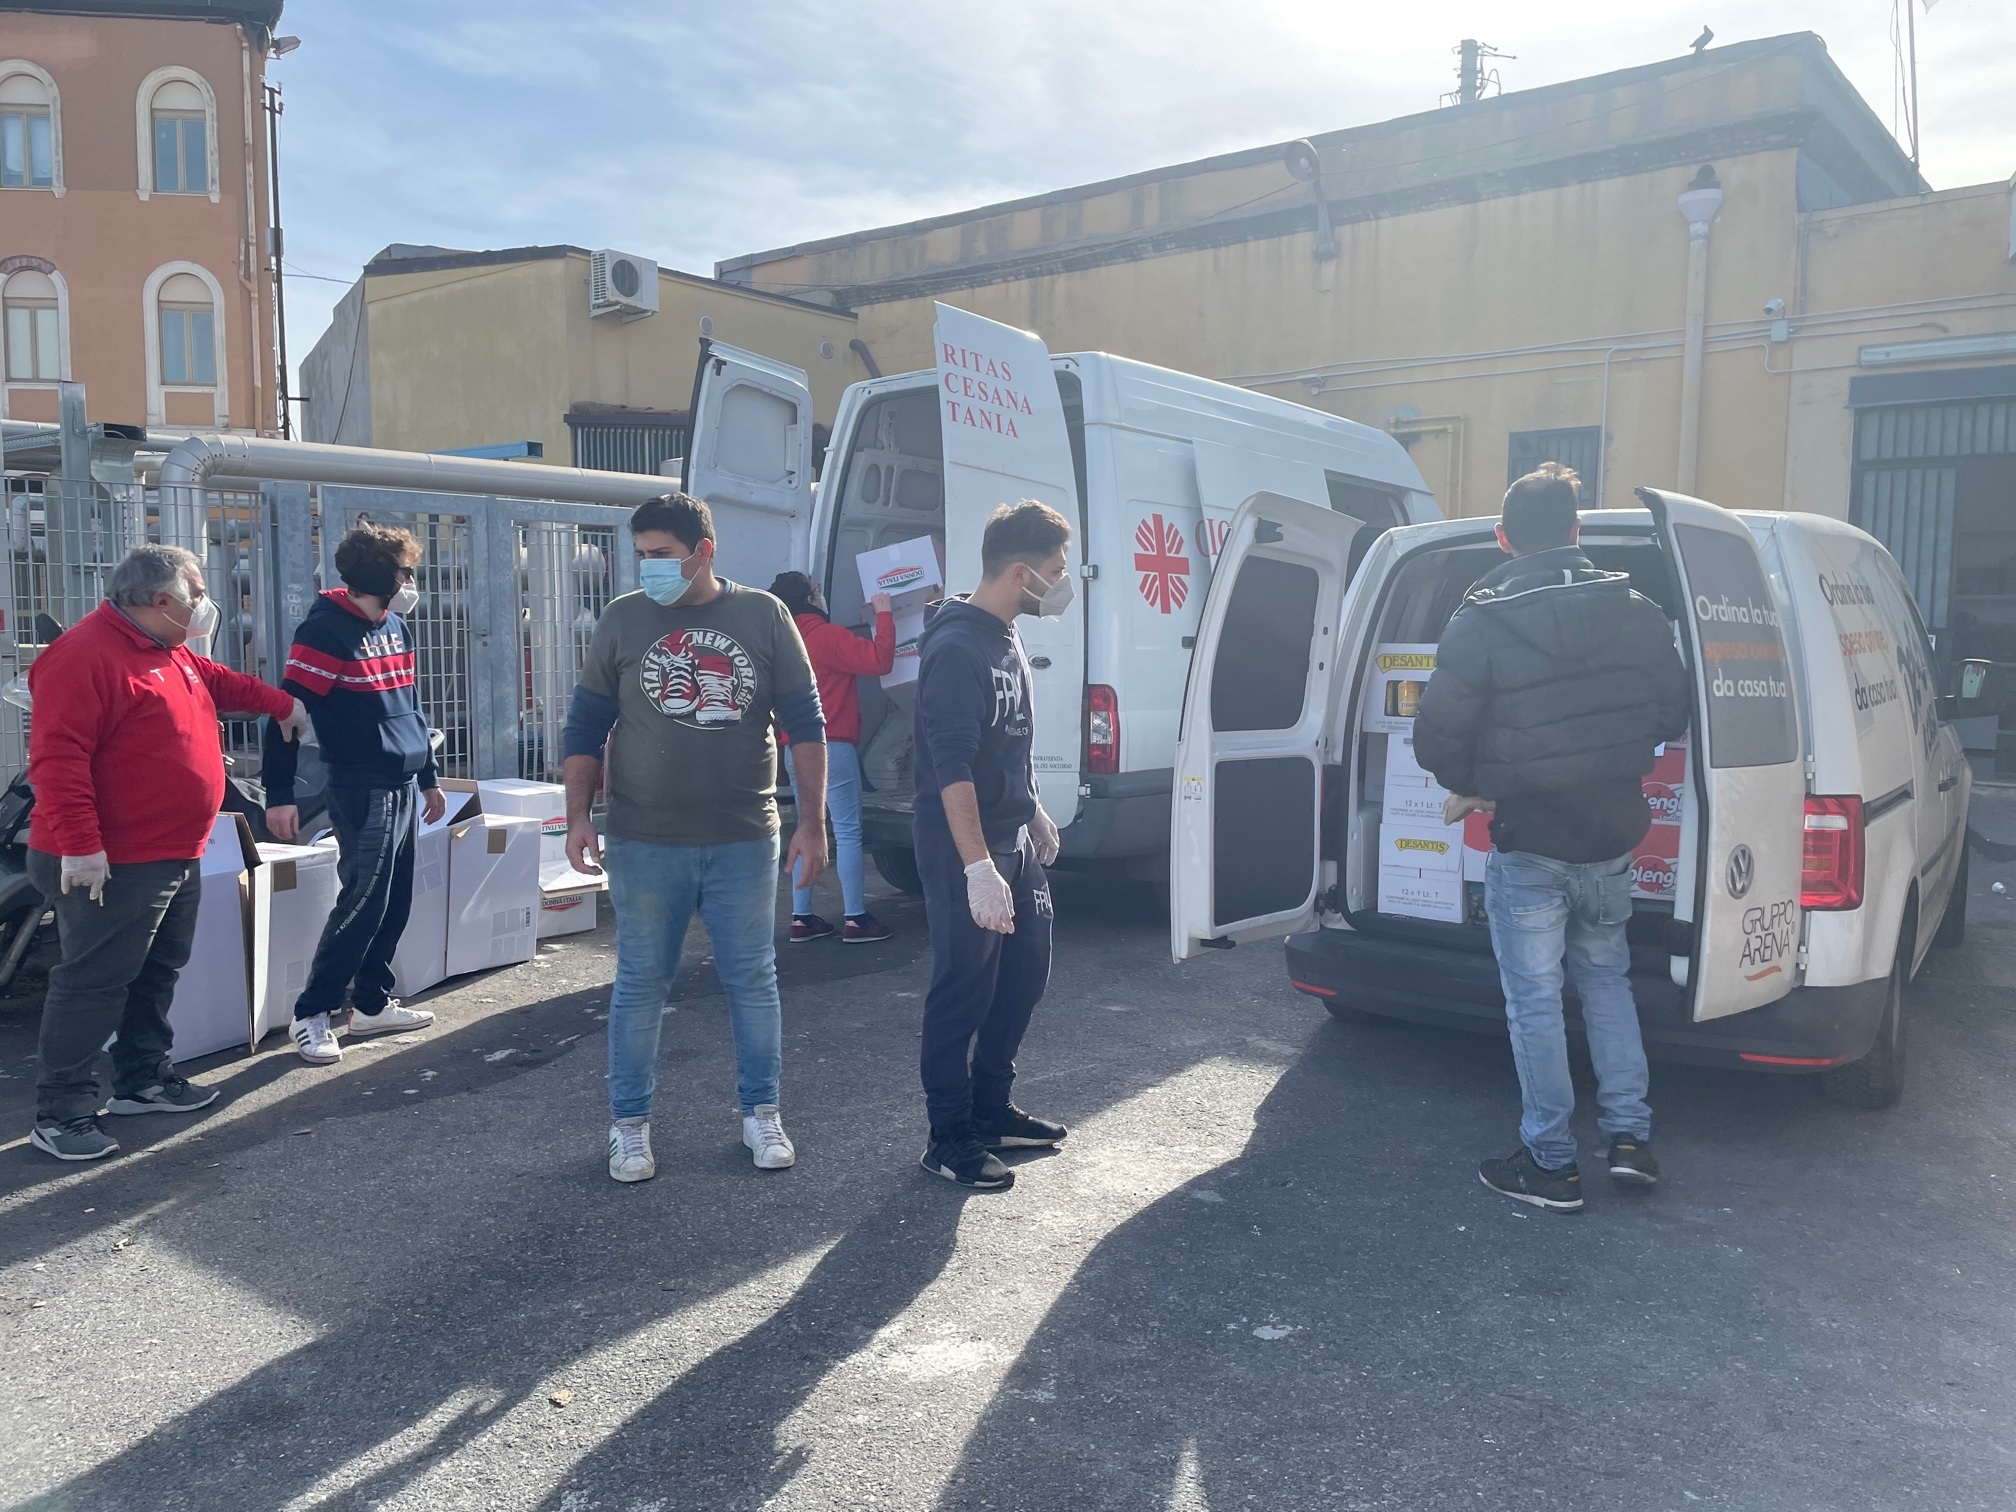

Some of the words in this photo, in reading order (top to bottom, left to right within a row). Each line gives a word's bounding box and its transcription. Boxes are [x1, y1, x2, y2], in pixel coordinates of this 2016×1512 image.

[942, 342, 1012, 382] RITAS
[944, 372, 1034, 416] CESANA
[946, 400, 1019, 439] TANIA
[1695, 593, 1750, 624] Ordina
[1748, 596, 1764, 625] la
[692, 631, 732, 651] NEW
[643, 652, 663, 699] STATE
[727, 645, 755, 691] YORK
[1383, 655, 1438, 669] DESANTI
[1713, 667, 1735, 697] da
[1737, 679, 1769, 697] casa
[1768, 675, 1787, 697] tua
[1400, 840, 1445, 853] DESANTIS
[542, 897, 563, 907] DONNA
[562, 895, 582, 904] ITALIA
[1401, 888, 1409, 896] 12
[1742, 899, 1794, 935] GRUPPO
[1739, 927, 1790, 969] ARENA
